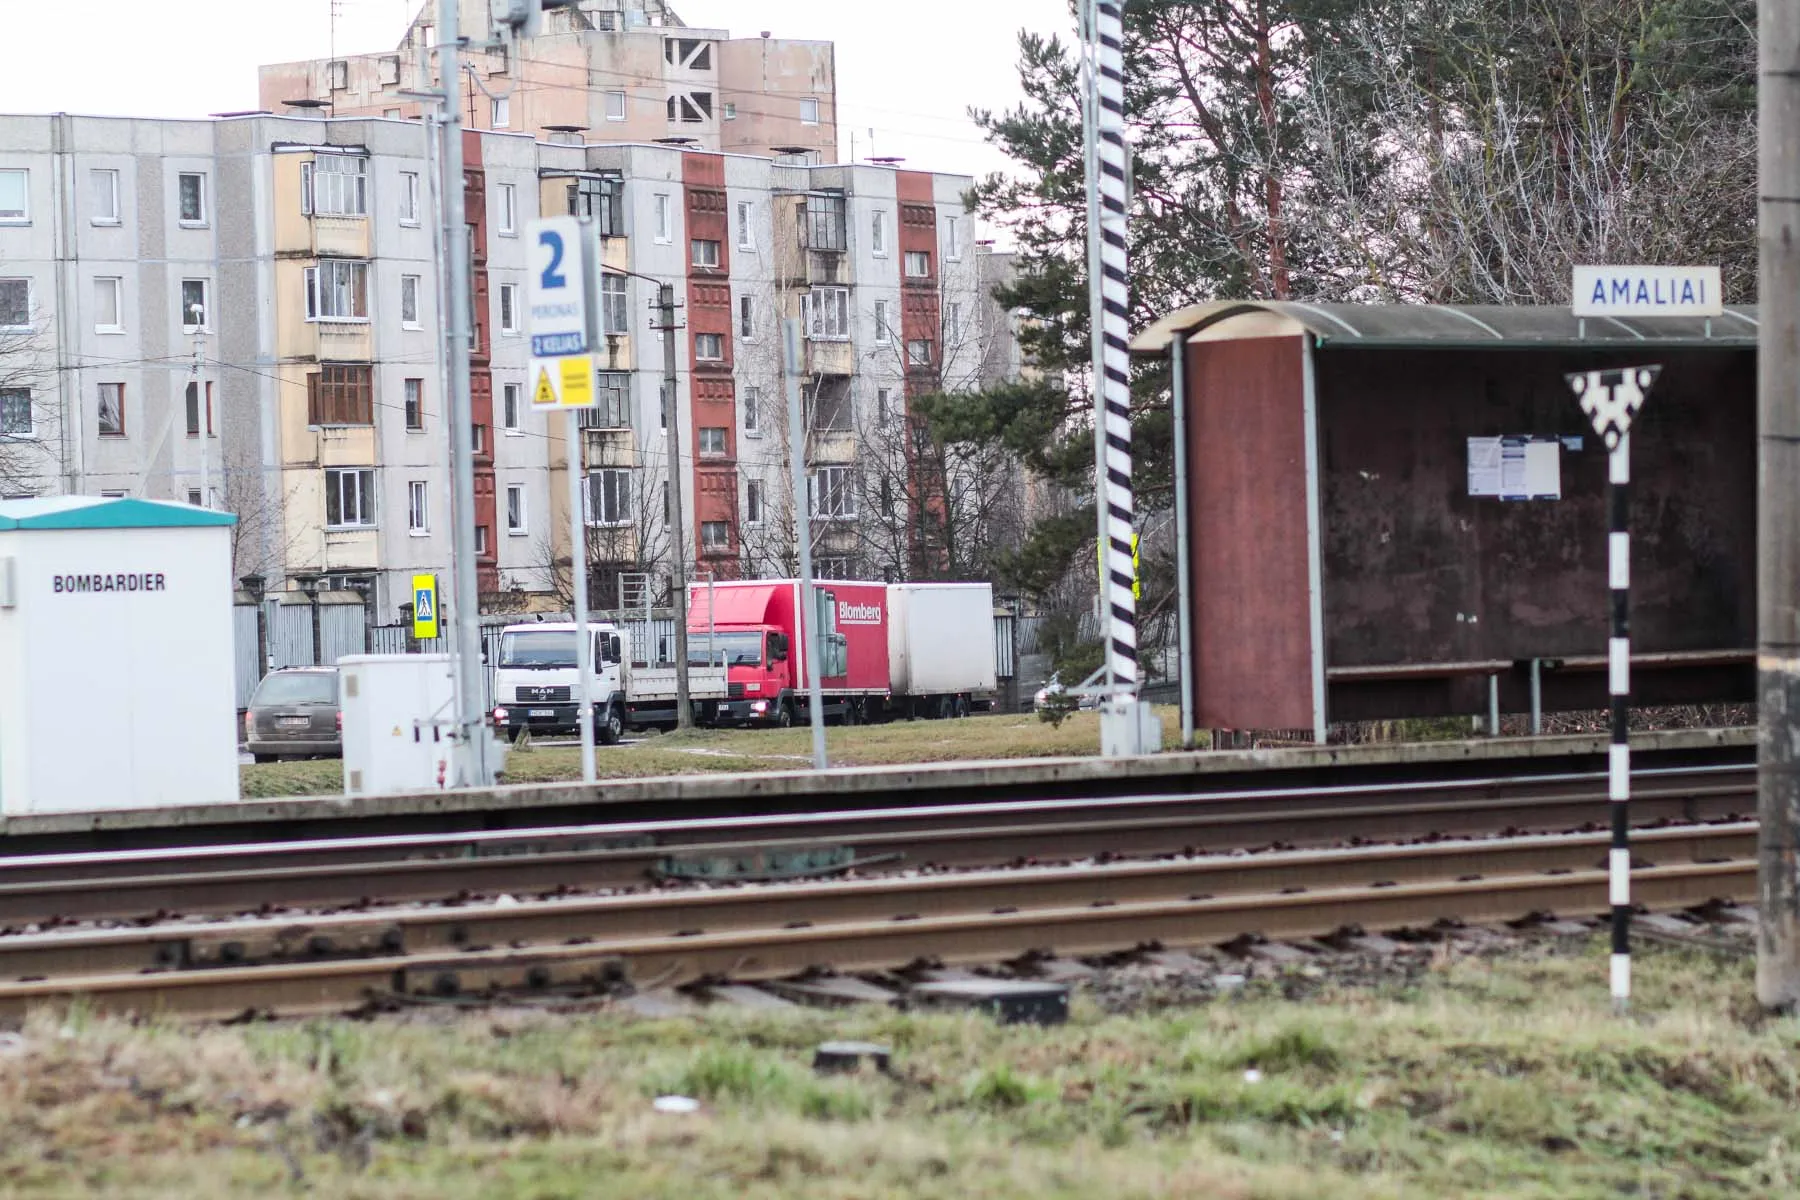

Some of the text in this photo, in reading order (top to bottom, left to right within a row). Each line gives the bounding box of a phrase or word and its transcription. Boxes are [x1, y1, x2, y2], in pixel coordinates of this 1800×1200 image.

[539, 230, 566, 290] 2
[1591, 278, 1705, 305] AMALIAI
[53, 573, 165, 593] BOMBARDIER
[839, 601, 881, 625] Blomberg
